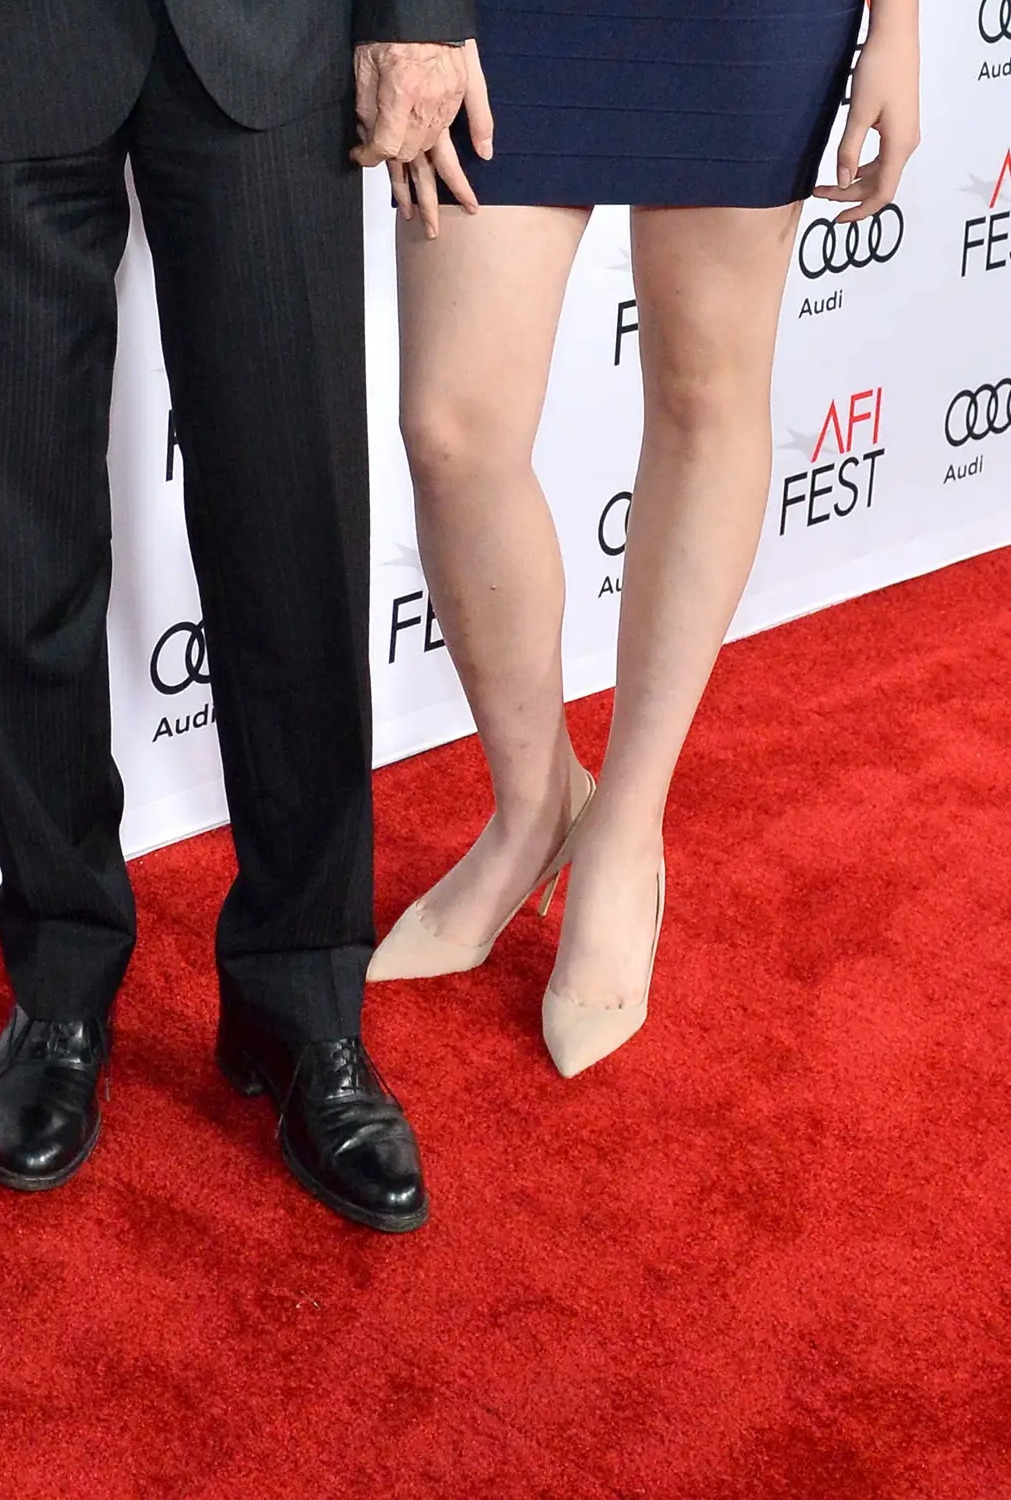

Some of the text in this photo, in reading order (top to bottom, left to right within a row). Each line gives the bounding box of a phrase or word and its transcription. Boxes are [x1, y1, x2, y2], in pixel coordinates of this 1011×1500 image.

[977, 56, 1011, 81] Aud
[798, 289, 843, 319] Audi
[810, 387, 882, 463] AFI
[943, 454, 983, 484] Audi
[779, 448, 885, 536] FEST
